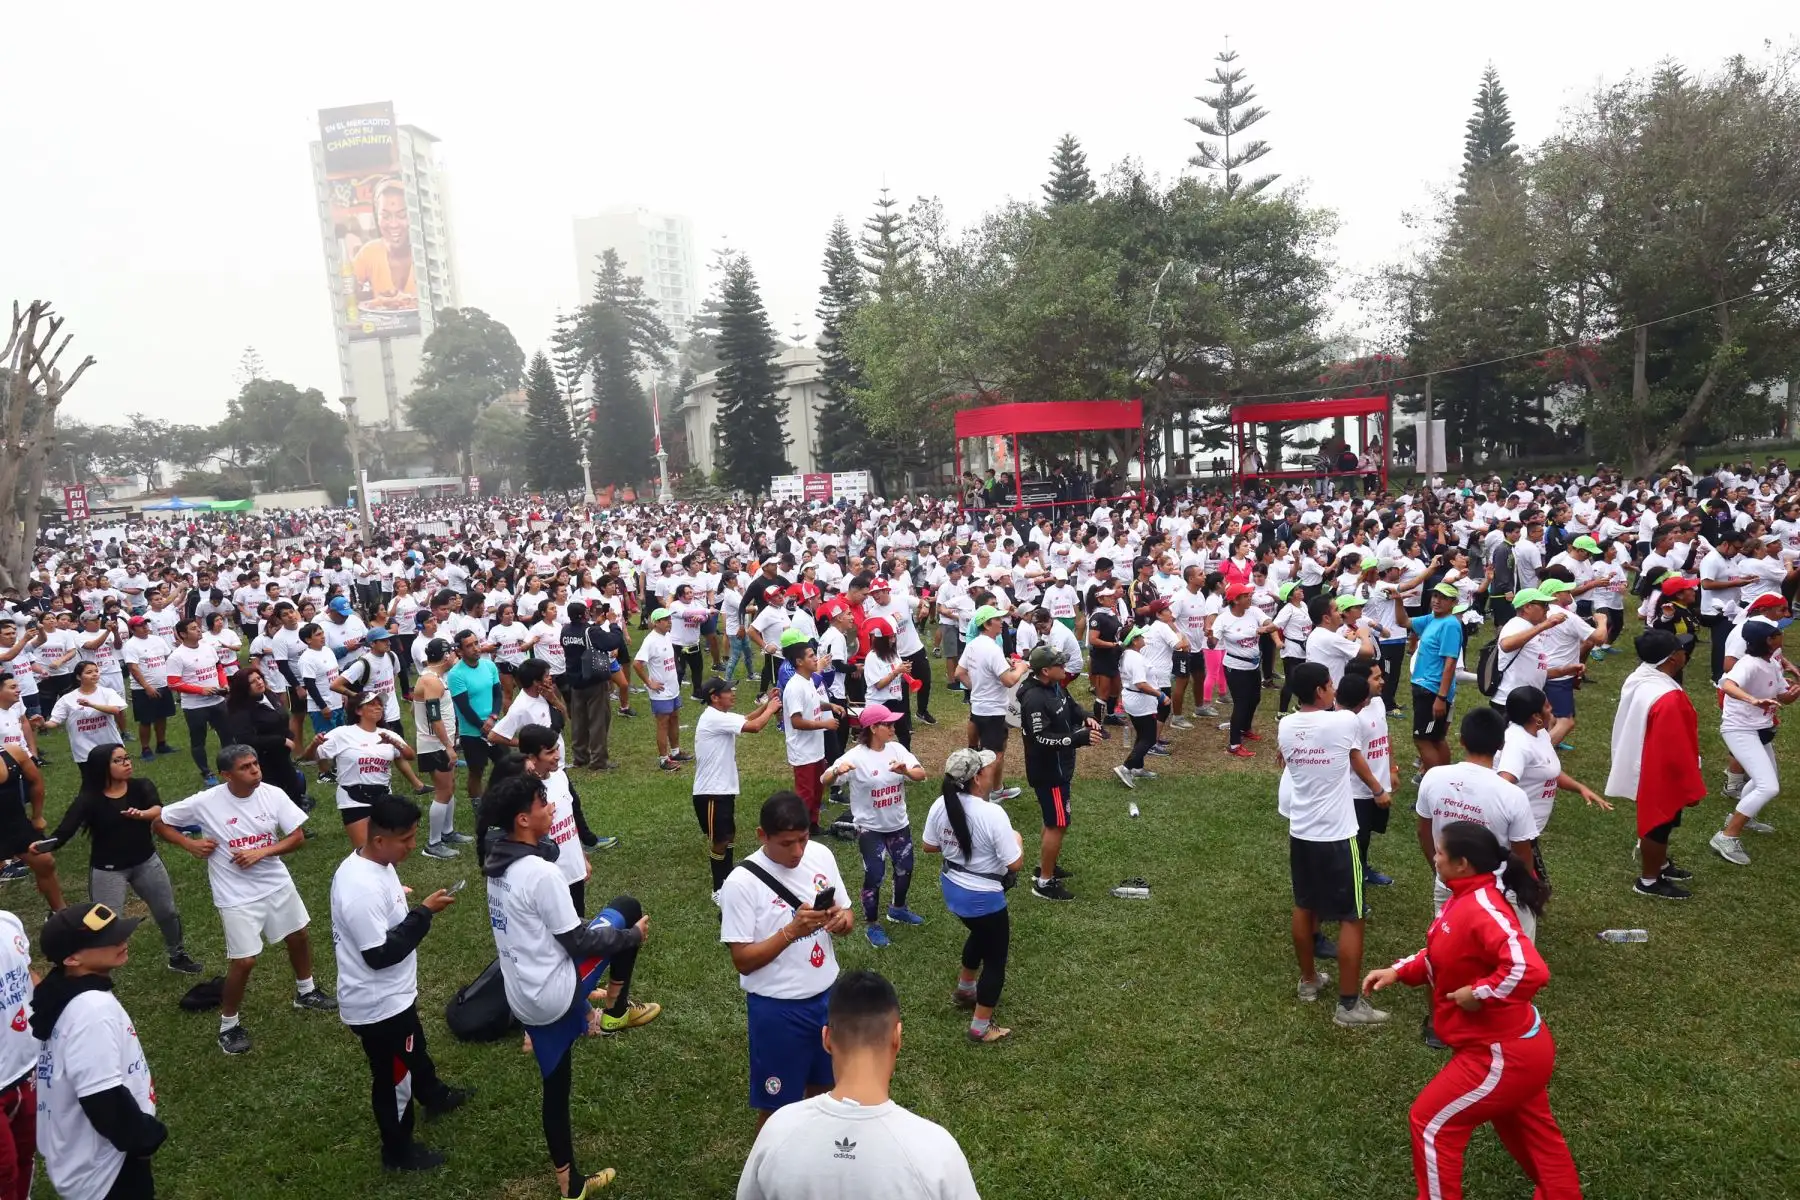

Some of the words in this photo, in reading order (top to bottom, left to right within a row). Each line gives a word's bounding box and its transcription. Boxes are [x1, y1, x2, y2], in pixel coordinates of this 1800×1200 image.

[346, 118, 390, 128] MERCADITO
[327, 134, 392, 152] CHANFAINITA
[70, 490, 82, 499] FU
[72, 500, 84, 508] ER
[73, 510, 86, 518] ZA
[871, 782, 902, 797] DEPORT
